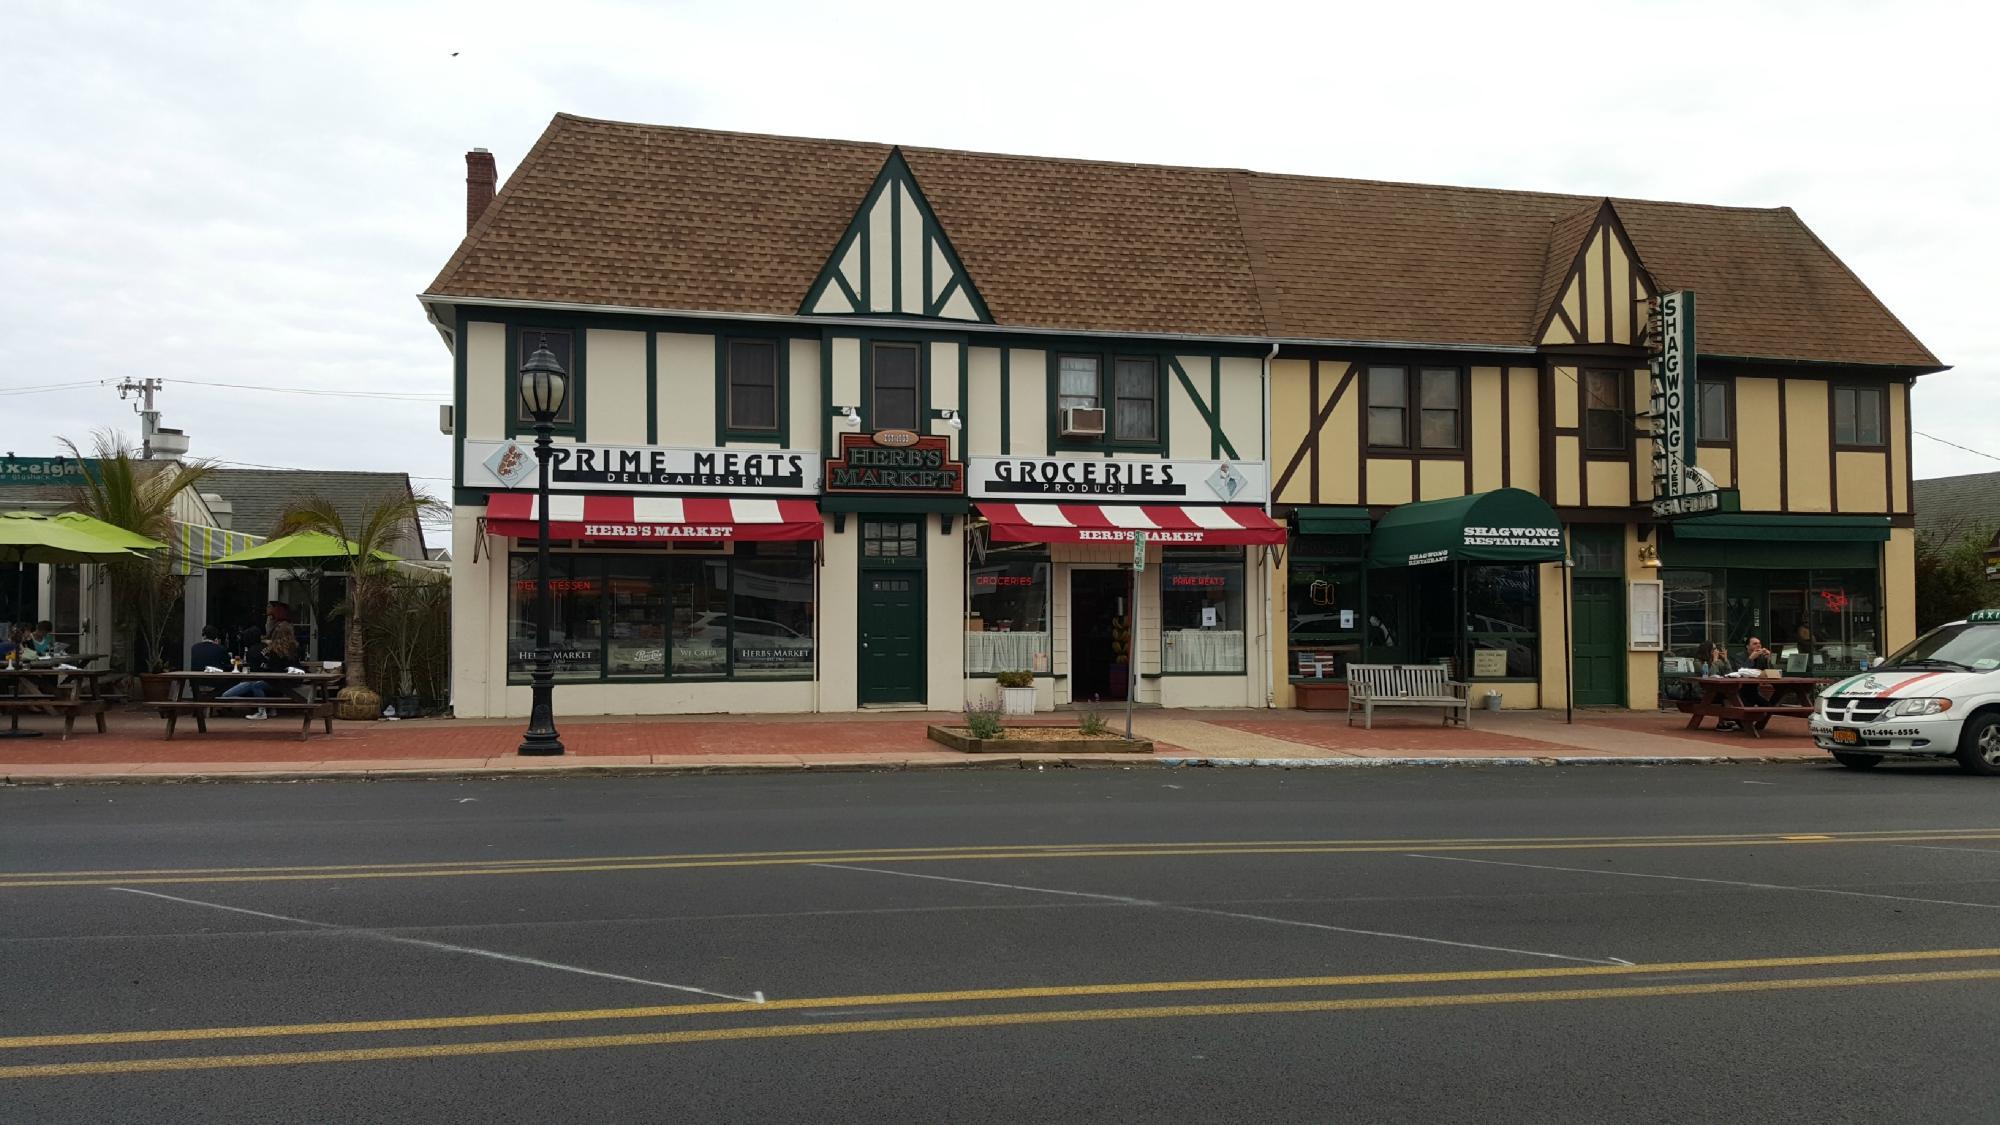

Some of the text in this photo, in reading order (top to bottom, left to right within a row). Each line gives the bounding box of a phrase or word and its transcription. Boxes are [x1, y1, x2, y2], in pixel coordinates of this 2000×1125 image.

[1664, 298, 1681, 447] SHAGWONG
[553, 449, 803, 476] PRIME MEATS
[848, 448, 942, 466] HERB'S
[832, 469, 957, 488] MARKET
[994, 461, 1174, 484] GROCERIES
[1669, 450, 1679, 495] TAVERN
[607, 472, 763, 486] DELICATESSEN
[1043, 484, 1126, 493] PRODUCE
[584, 525, 733, 537] HERB'S MARKET
[1079, 530, 1204, 542] HERB'S ARKET
[1463, 527, 1560, 537] SHAGWONG
[1463, 537, 1560, 546] RESTAURANT
[1408, 549, 1449, 560] SHAGWONG
[1408, 555, 1449, 566] RESTAURANT
[976, 576, 1032, 585] GROCERIES
[553, 651, 593, 659] MARKET
[774, 649, 809, 657] MARKET
